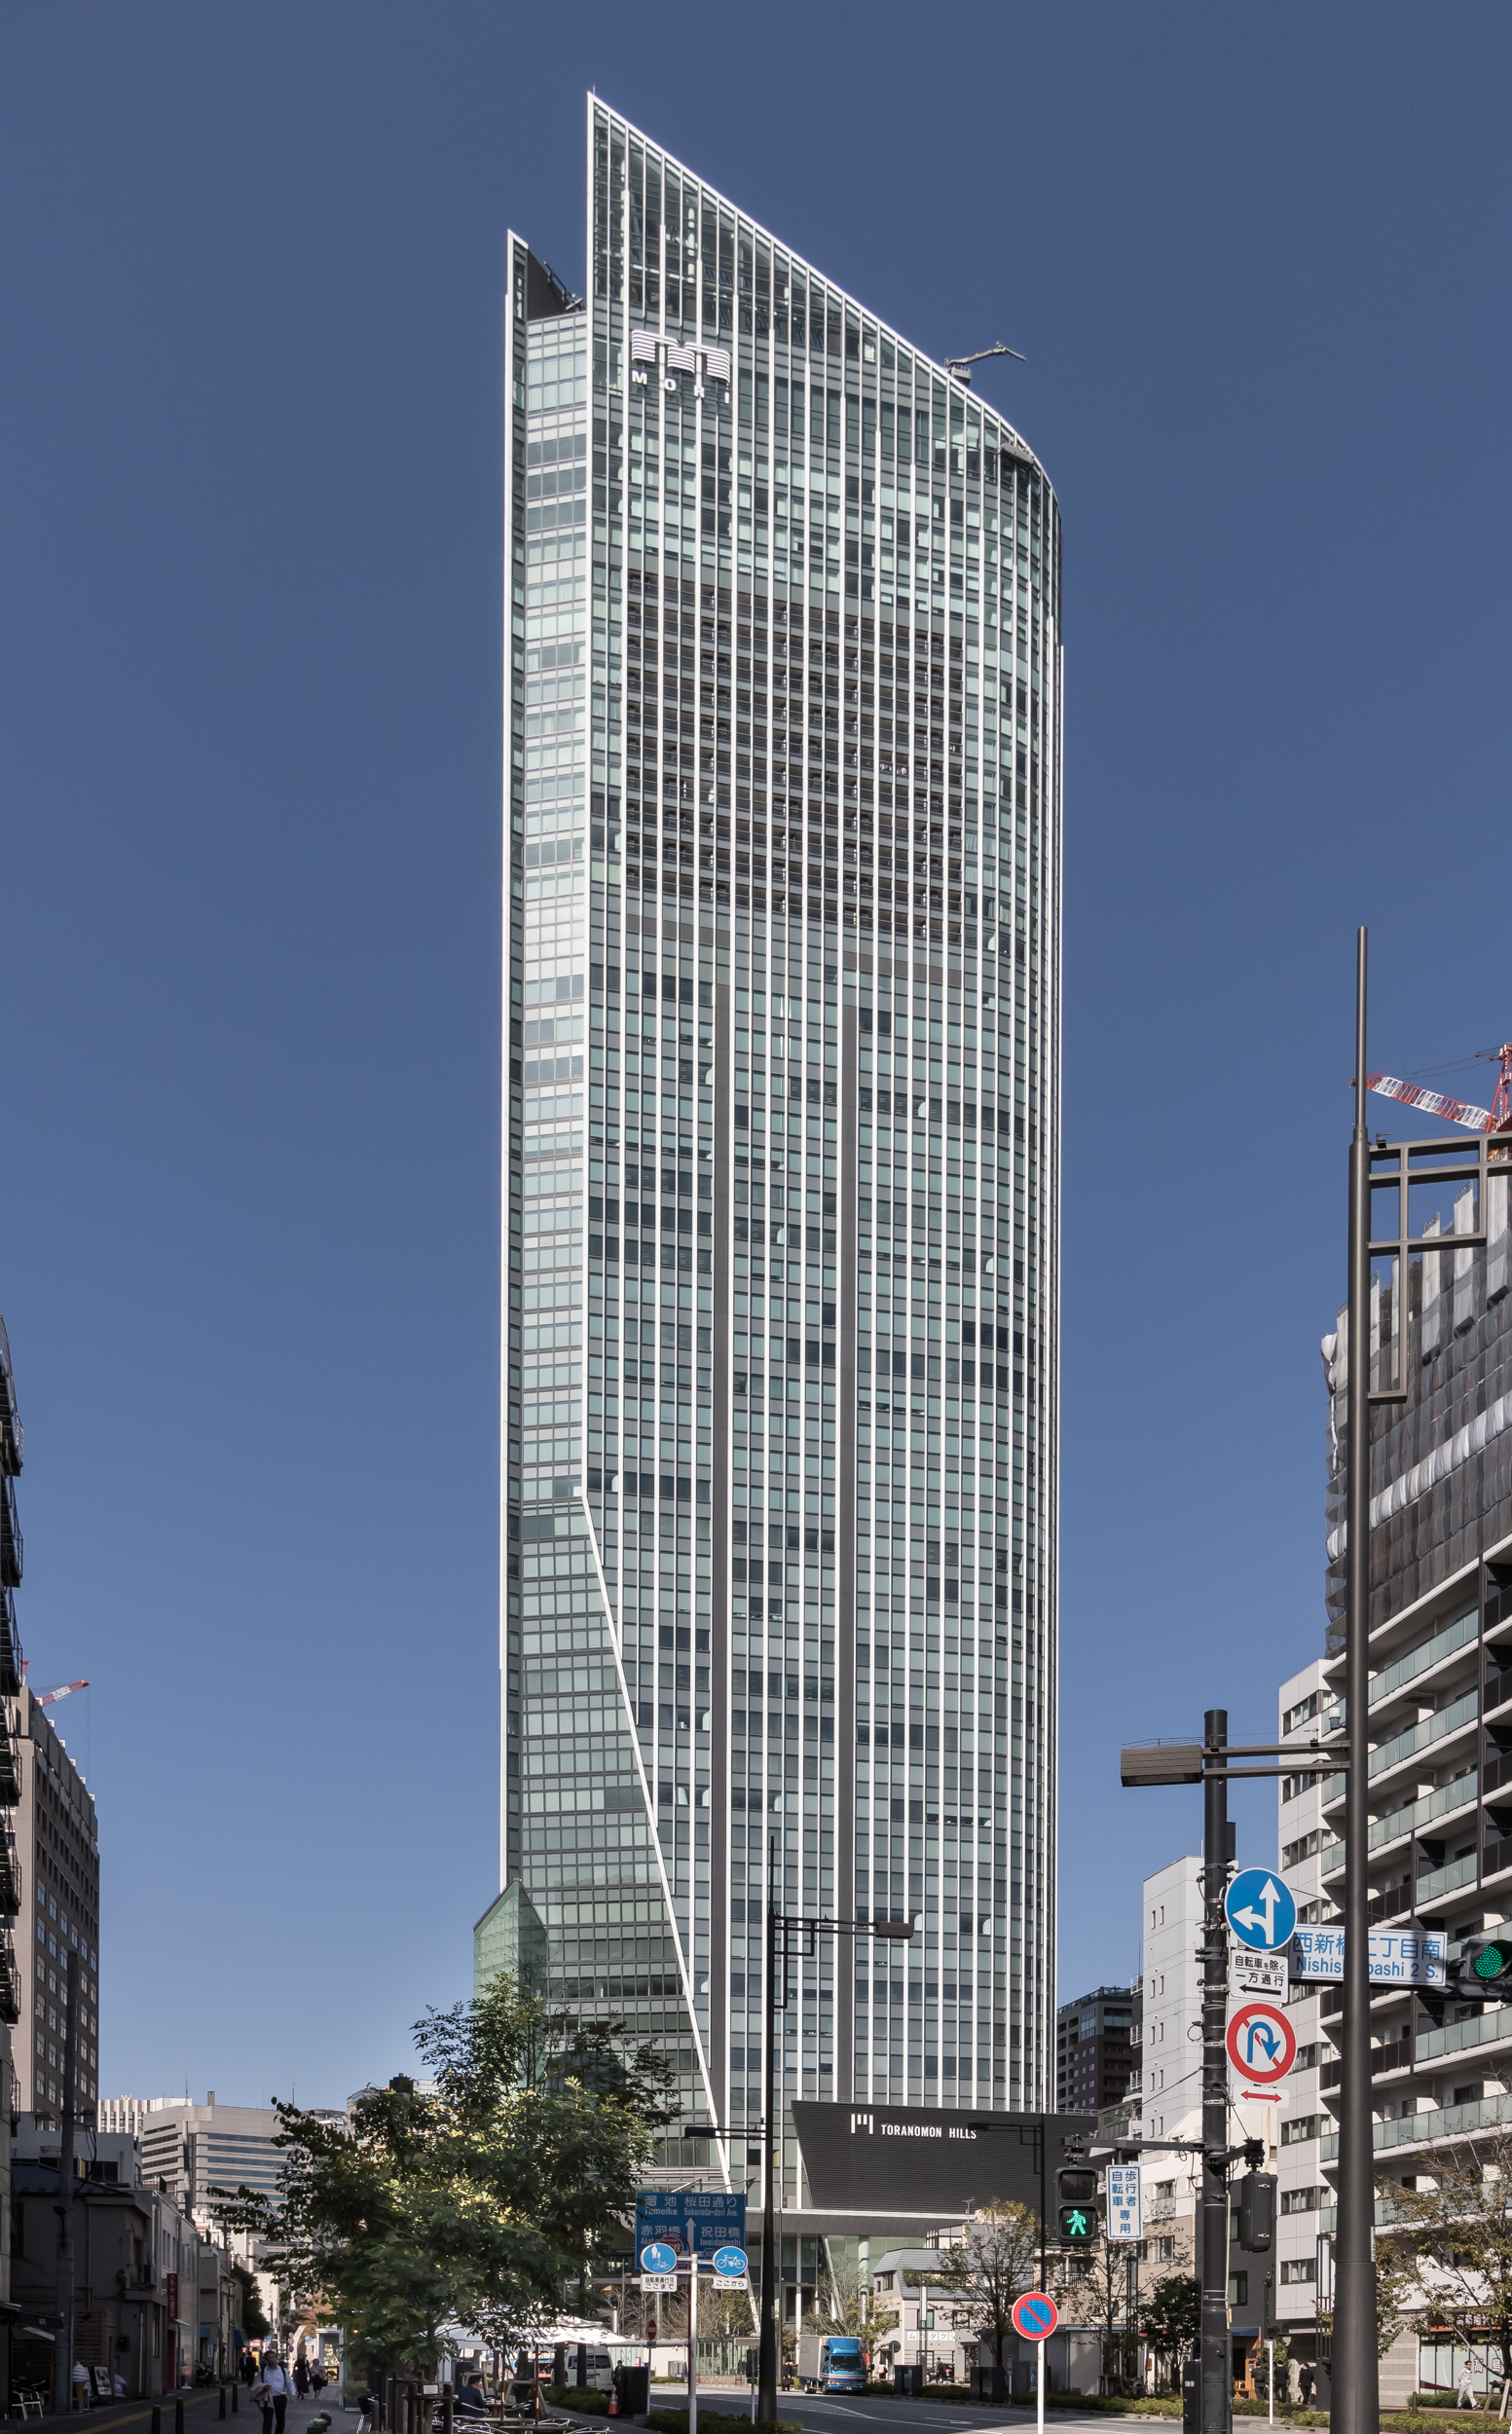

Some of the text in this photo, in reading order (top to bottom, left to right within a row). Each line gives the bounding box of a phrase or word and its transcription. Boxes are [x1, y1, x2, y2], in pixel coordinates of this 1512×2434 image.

[632, 370, 730, 404] MORI
[1235, 1955, 1285, 1973] 自転車を除く
[1410, 1962, 1420, 1977] 2
[1424, 1963, 1439, 1978] S.
[1235, 1972, 1285, 1987] 一方通行
[881, 2124, 977, 2140] TORANOMON HILLS
[684, 2195, 737, 2207] 桜田通り
[701, 2227, 740, 2238] 祝田橋
